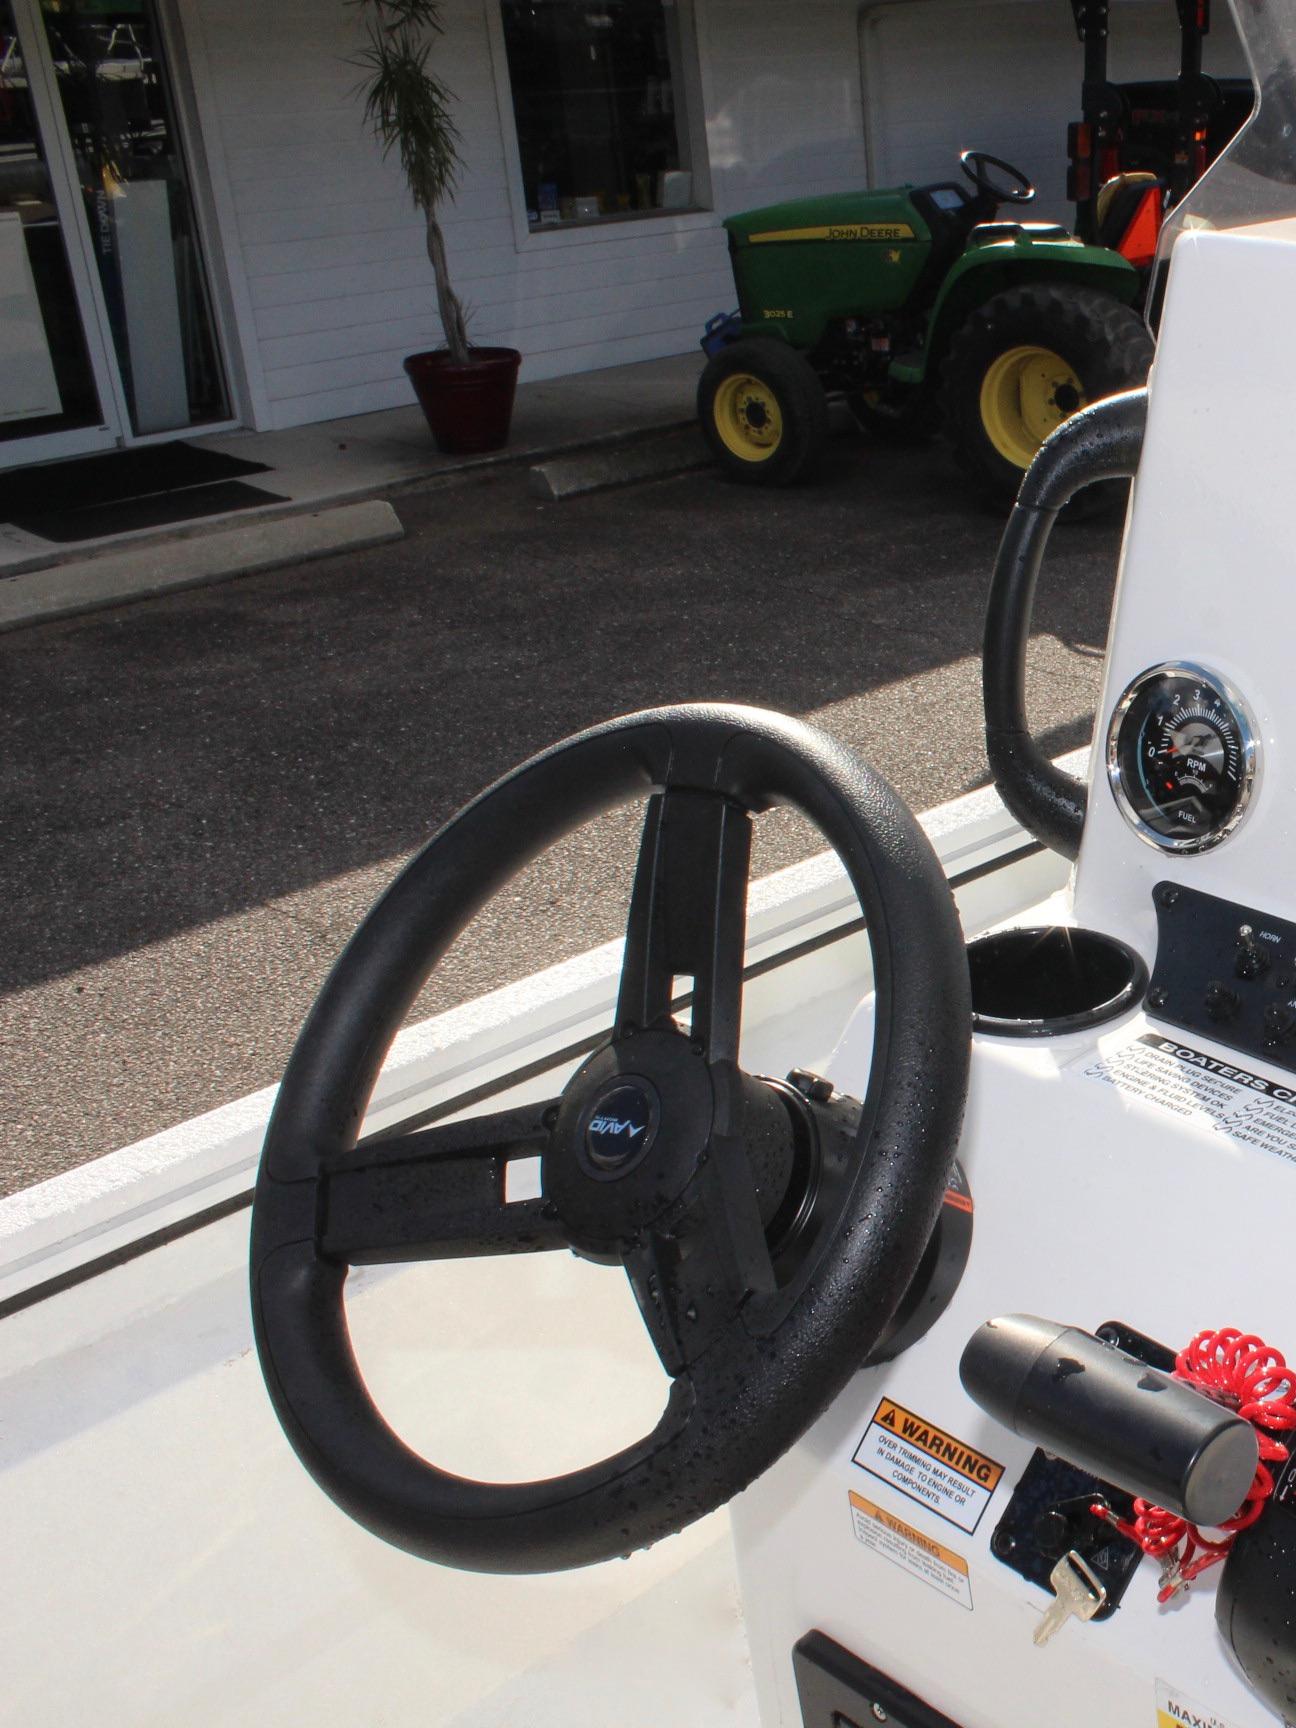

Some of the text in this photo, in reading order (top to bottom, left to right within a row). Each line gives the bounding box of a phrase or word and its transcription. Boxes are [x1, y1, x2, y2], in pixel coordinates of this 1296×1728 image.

[825, 226, 901, 240] JOHN DEERE
[1172, 694, 1181, 706] 2
[1193, 689, 1200, 701] 3
[1157, 715, 1164, 726] 1
[1148, 745, 1156, 758] 0
[1187, 758, 1207, 772] RPM
[1178, 810, 1197, 824] FUEL
[1259, 931, 1282, 944] HORN
[1158, 1042, 1269, 1091] BOATERS
[1155, 1065, 1190, 1083] SAVING
[1190, 1080, 1233, 1101] DEVICES
[1175, 1063, 1203, 1078] PLUG
[1200, 1074, 1242, 1094] SECURE
[1103, 1075, 1193, 1116] BATTERY CHARGED
[1113, 1069, 1149, 1087] ENGINE
[1159, 1087, 1187, 1103] FLUID
[1186, 1099, 1225, 1119] LEVELS
[1171, 1083, 1211, 1102] SYSTEM
[1210, 1099, 1228, 1109] OK
[1263, 1111, 1289, 1126] FUEL
[1232, 1130, 1260, 1145] SAFE
[1244, 1124, 1267, 1138] ARE
[1265, 1133, 1288, 1147] YOU
[902, 1417, 992, 1483] WARNING
[877, 1448, 967, 1506] IN DAMAGE TO ENGINE OR
[878, 1435, 977, 1499] OVER TRIMMING MAY RESULT
[892, 1470, 941, 1505] COMPONENTS.
